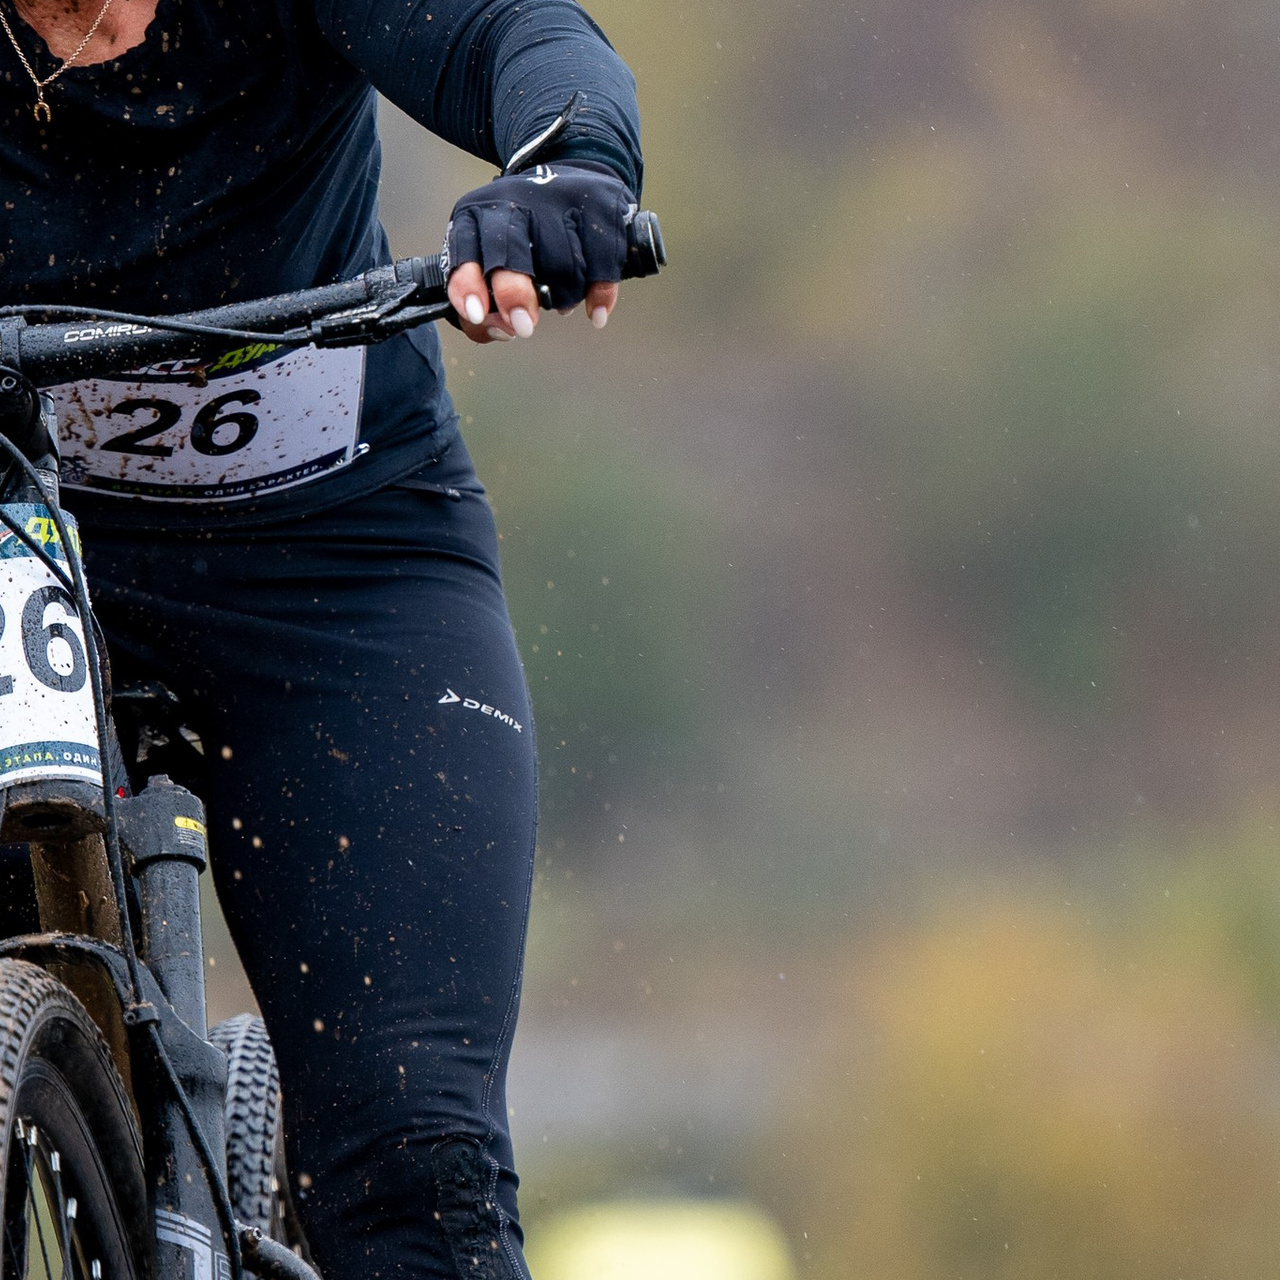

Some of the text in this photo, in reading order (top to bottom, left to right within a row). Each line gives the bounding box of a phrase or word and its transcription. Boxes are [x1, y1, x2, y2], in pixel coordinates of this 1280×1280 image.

[100, 389, 262, 458] 26
[463, 698, 523, 733] DEMIX
[5, 751, 60, 768] ЭТАПА.
[63, 752, 98, 766] ОДИН
